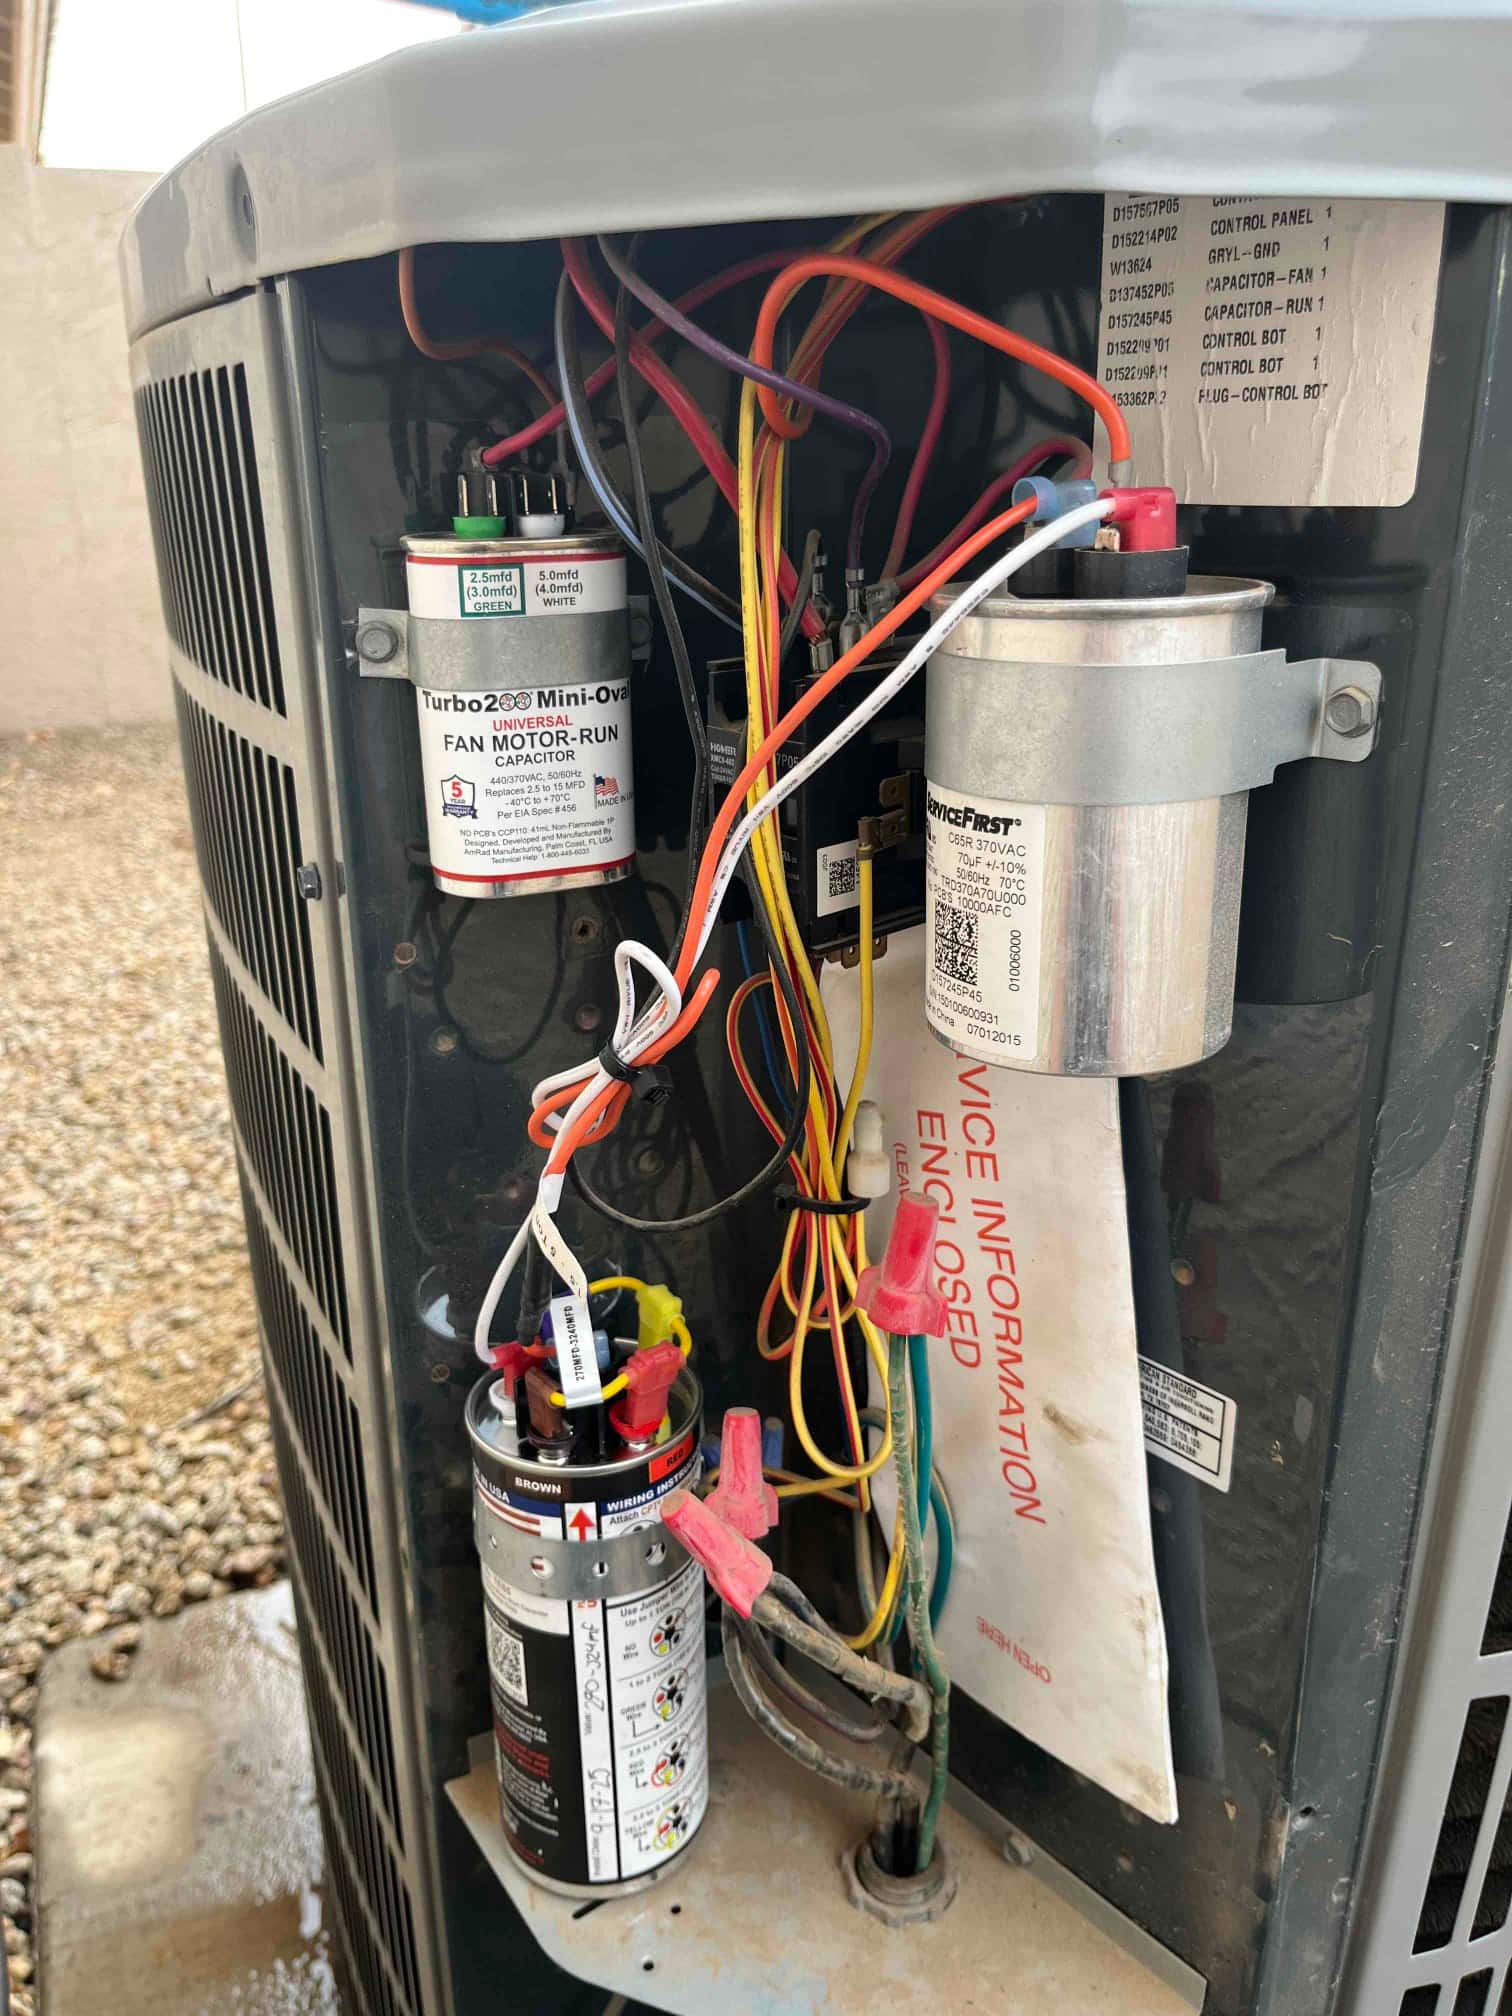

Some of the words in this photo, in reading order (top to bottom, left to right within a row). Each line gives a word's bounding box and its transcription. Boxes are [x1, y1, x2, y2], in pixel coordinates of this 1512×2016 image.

[1211, 215, 1266, 236] CONTROL
[1272, 208, 1313, 227] PANEL
[1326, 206, 1332, 218] 1
[1110, 259, 1152, 276] W13624
[1323, 236, 1329, 250] 1
[1320, 267, 1326, 280] 1
[1318, 297, 1324, 311] 1
[1203, 331, 1257, 349] CONTROL
[1262, 329, 1286, 345] BOT
[1315, 327, 1321, 341] 1
[1200, 359, 1254, 377] CONTROL
[1259, 358, 1284, 373] BOT
[1313, 356, 1319, 370] 1
[470, 571, 512, 583] 2.5mfd
[539, 569, 579, 582] 5.0mfd
[466, 584, 518, 599] (3.0mfd)
[535, 582, 583, 595] (4.0mfd)
[473, 601, 512, 612] GREEN
[543, 597, 577, 607] WHITE
[493, 714, 574, 732] UNIVERSAL
[444, 734, 484, 752] FAN
[492, 724, 618, 752] MOTOR-RUN
[495, 750, 575, 767] CAPACITOR
[547, 770, 582, 781] 50/60Hz
[452, 780, 463, 798] 5
[485, 787, 525, 798] Replaces
[527, 785, 540, 794] 2.5
[553, 783, 563, 791] 15
[566, 780, 585, 789] MFD
[533, 797, 541, 805] to
[497, 811, 513, 819] Per
[514, 809, 530, 818] EIA
[532, 807, 552, 816] Spec
[948, 832, 973, 848] C65R
[977, 839, 1026, 857] 370VAC
[1000, 877, 1025, 891] 70°C
[1008, 929, 1021, 992] 01006000
[967, 1023, 1022, 1046] 07012015
[956, 1051, 999, 1182] VICE
[893, 1142, 911, 1199] (LEAV
[971, 1197, 1046, 1525] INFORMATION
[667, 1447, 684, 1468] RED
[489, 1483, 510, 1504] USA
[515, 1477, 561, 1494] BROWN
[606, 1490, 655, 1512] WIRING
[609, 1511, 639, 1525] Attach
